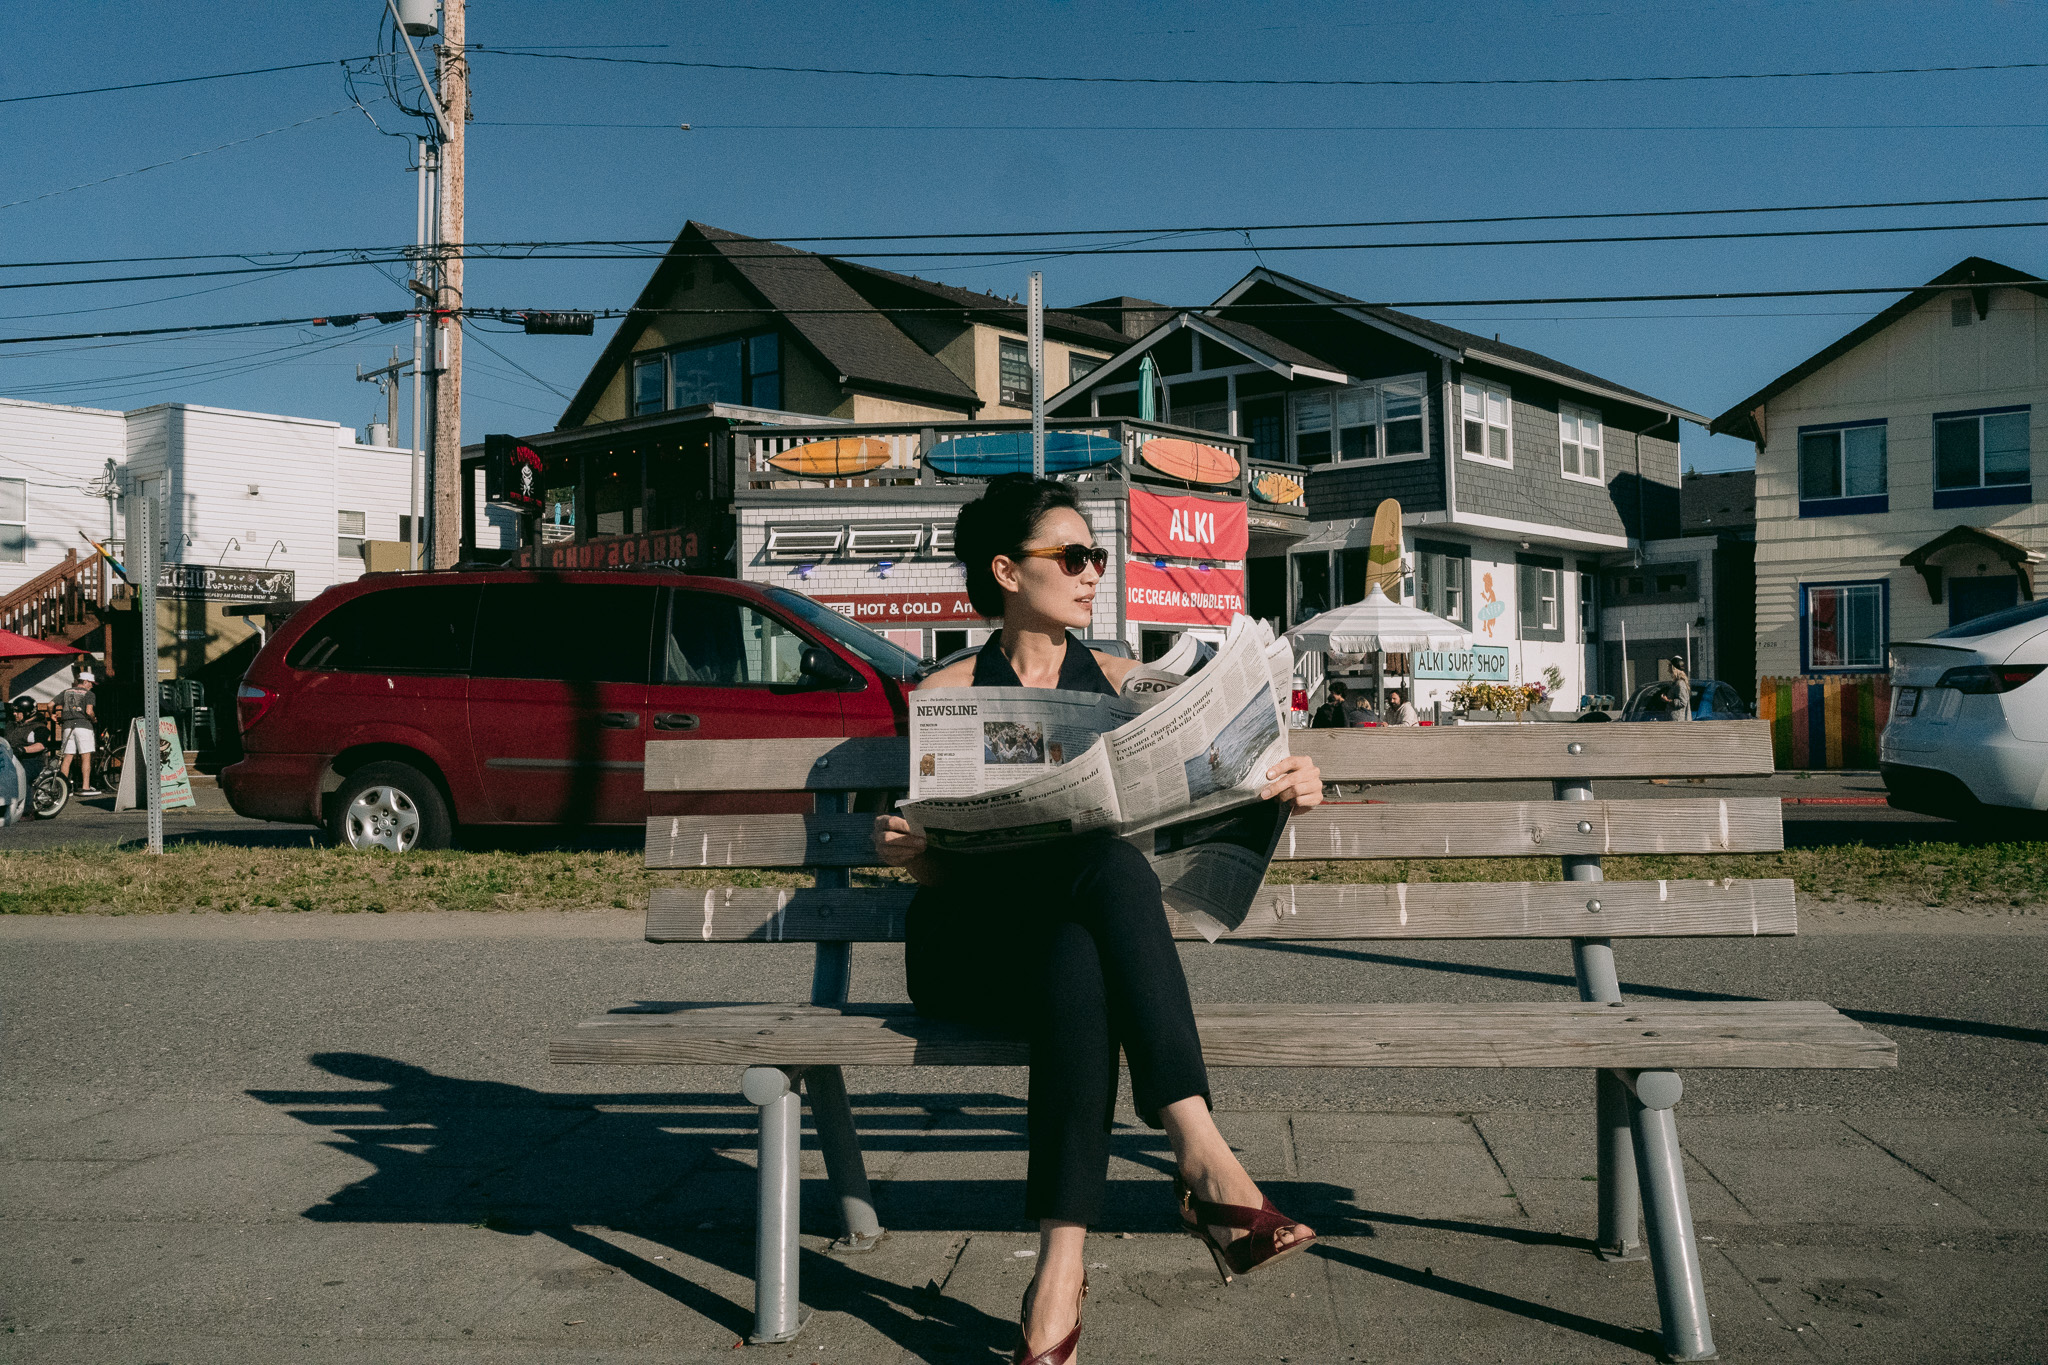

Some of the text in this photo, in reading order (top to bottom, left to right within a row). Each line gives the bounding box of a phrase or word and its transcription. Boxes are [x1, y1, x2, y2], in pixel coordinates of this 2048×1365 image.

[1169, 509, 1215, 544] ALKI
[173, 569, 216, 589] CHUP
[857, 603, 886, 616] HOT
[889, 604, 899, 615] &
[902, 602, 941, 615] COLD
[1128, 587, 1242, 610] ICE CREAM & BUBBLE TEA
[1418, 652, 1505, 673] ALKI SURF SHOP
[1133, 682, 1176, 693] SPO
[917, 705, 978, 716] NEWSLINE
[1115, 687, 1214, 755] Two men charged with murder
[1113, 728, 1146, 748] NORTHWEST
[1126, 740, 1156, 757] shooting
[1164, 715, 1192, 736] Tukwila
[1192, 699, 1211, 717] Costco
[968, 805, 988, 813] puts
[990, 798, 1026, 809] funding
[1028, 785, 1066, 802] proposal
[1068, 781, 1080, 789] on
[1081, 768, 1099, 783] hold
